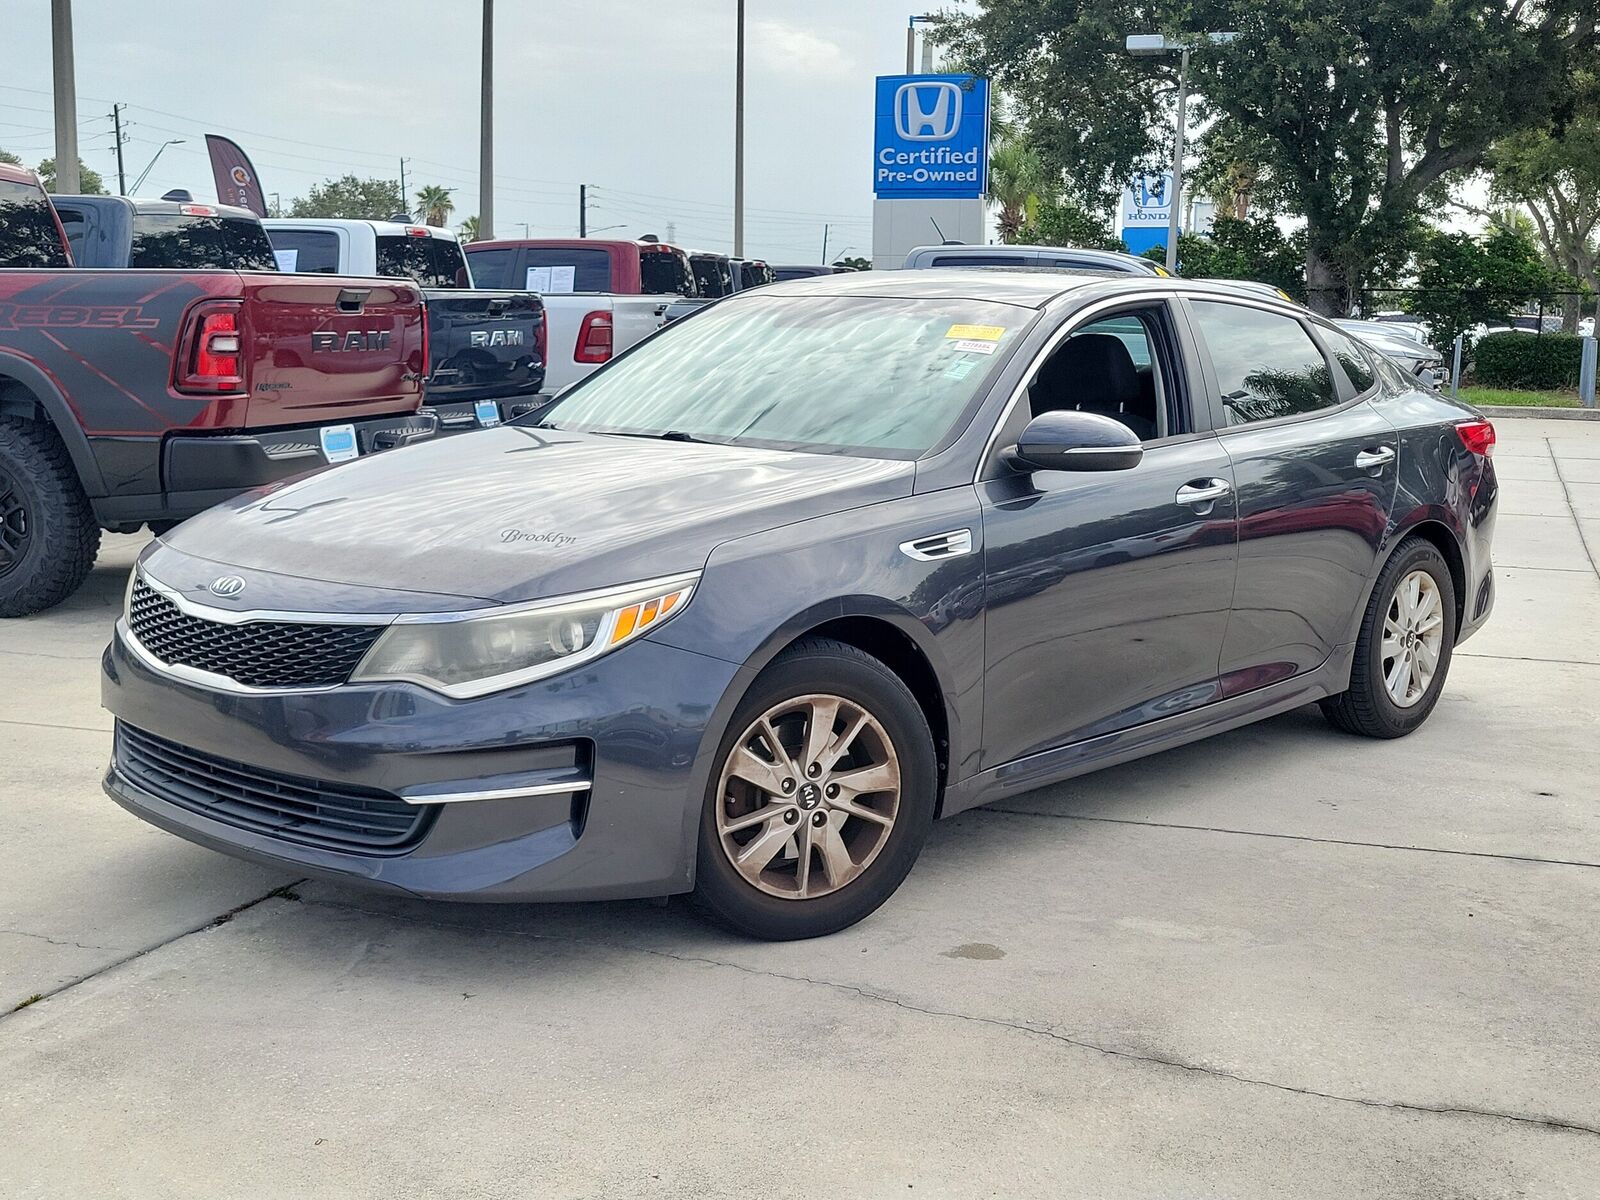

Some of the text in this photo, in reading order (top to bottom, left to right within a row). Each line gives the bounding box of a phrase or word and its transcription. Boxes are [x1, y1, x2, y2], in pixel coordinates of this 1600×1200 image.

[879, 147, 977, 165] Certified
[878, 168, 977, 182] Pre-Owned
[312, 331, 390, 352] RAM
[470, 331, 523, 347] RAM
[500, 529, 577, 547] Brooklyn
[803, 785, 816, 808] KIA
